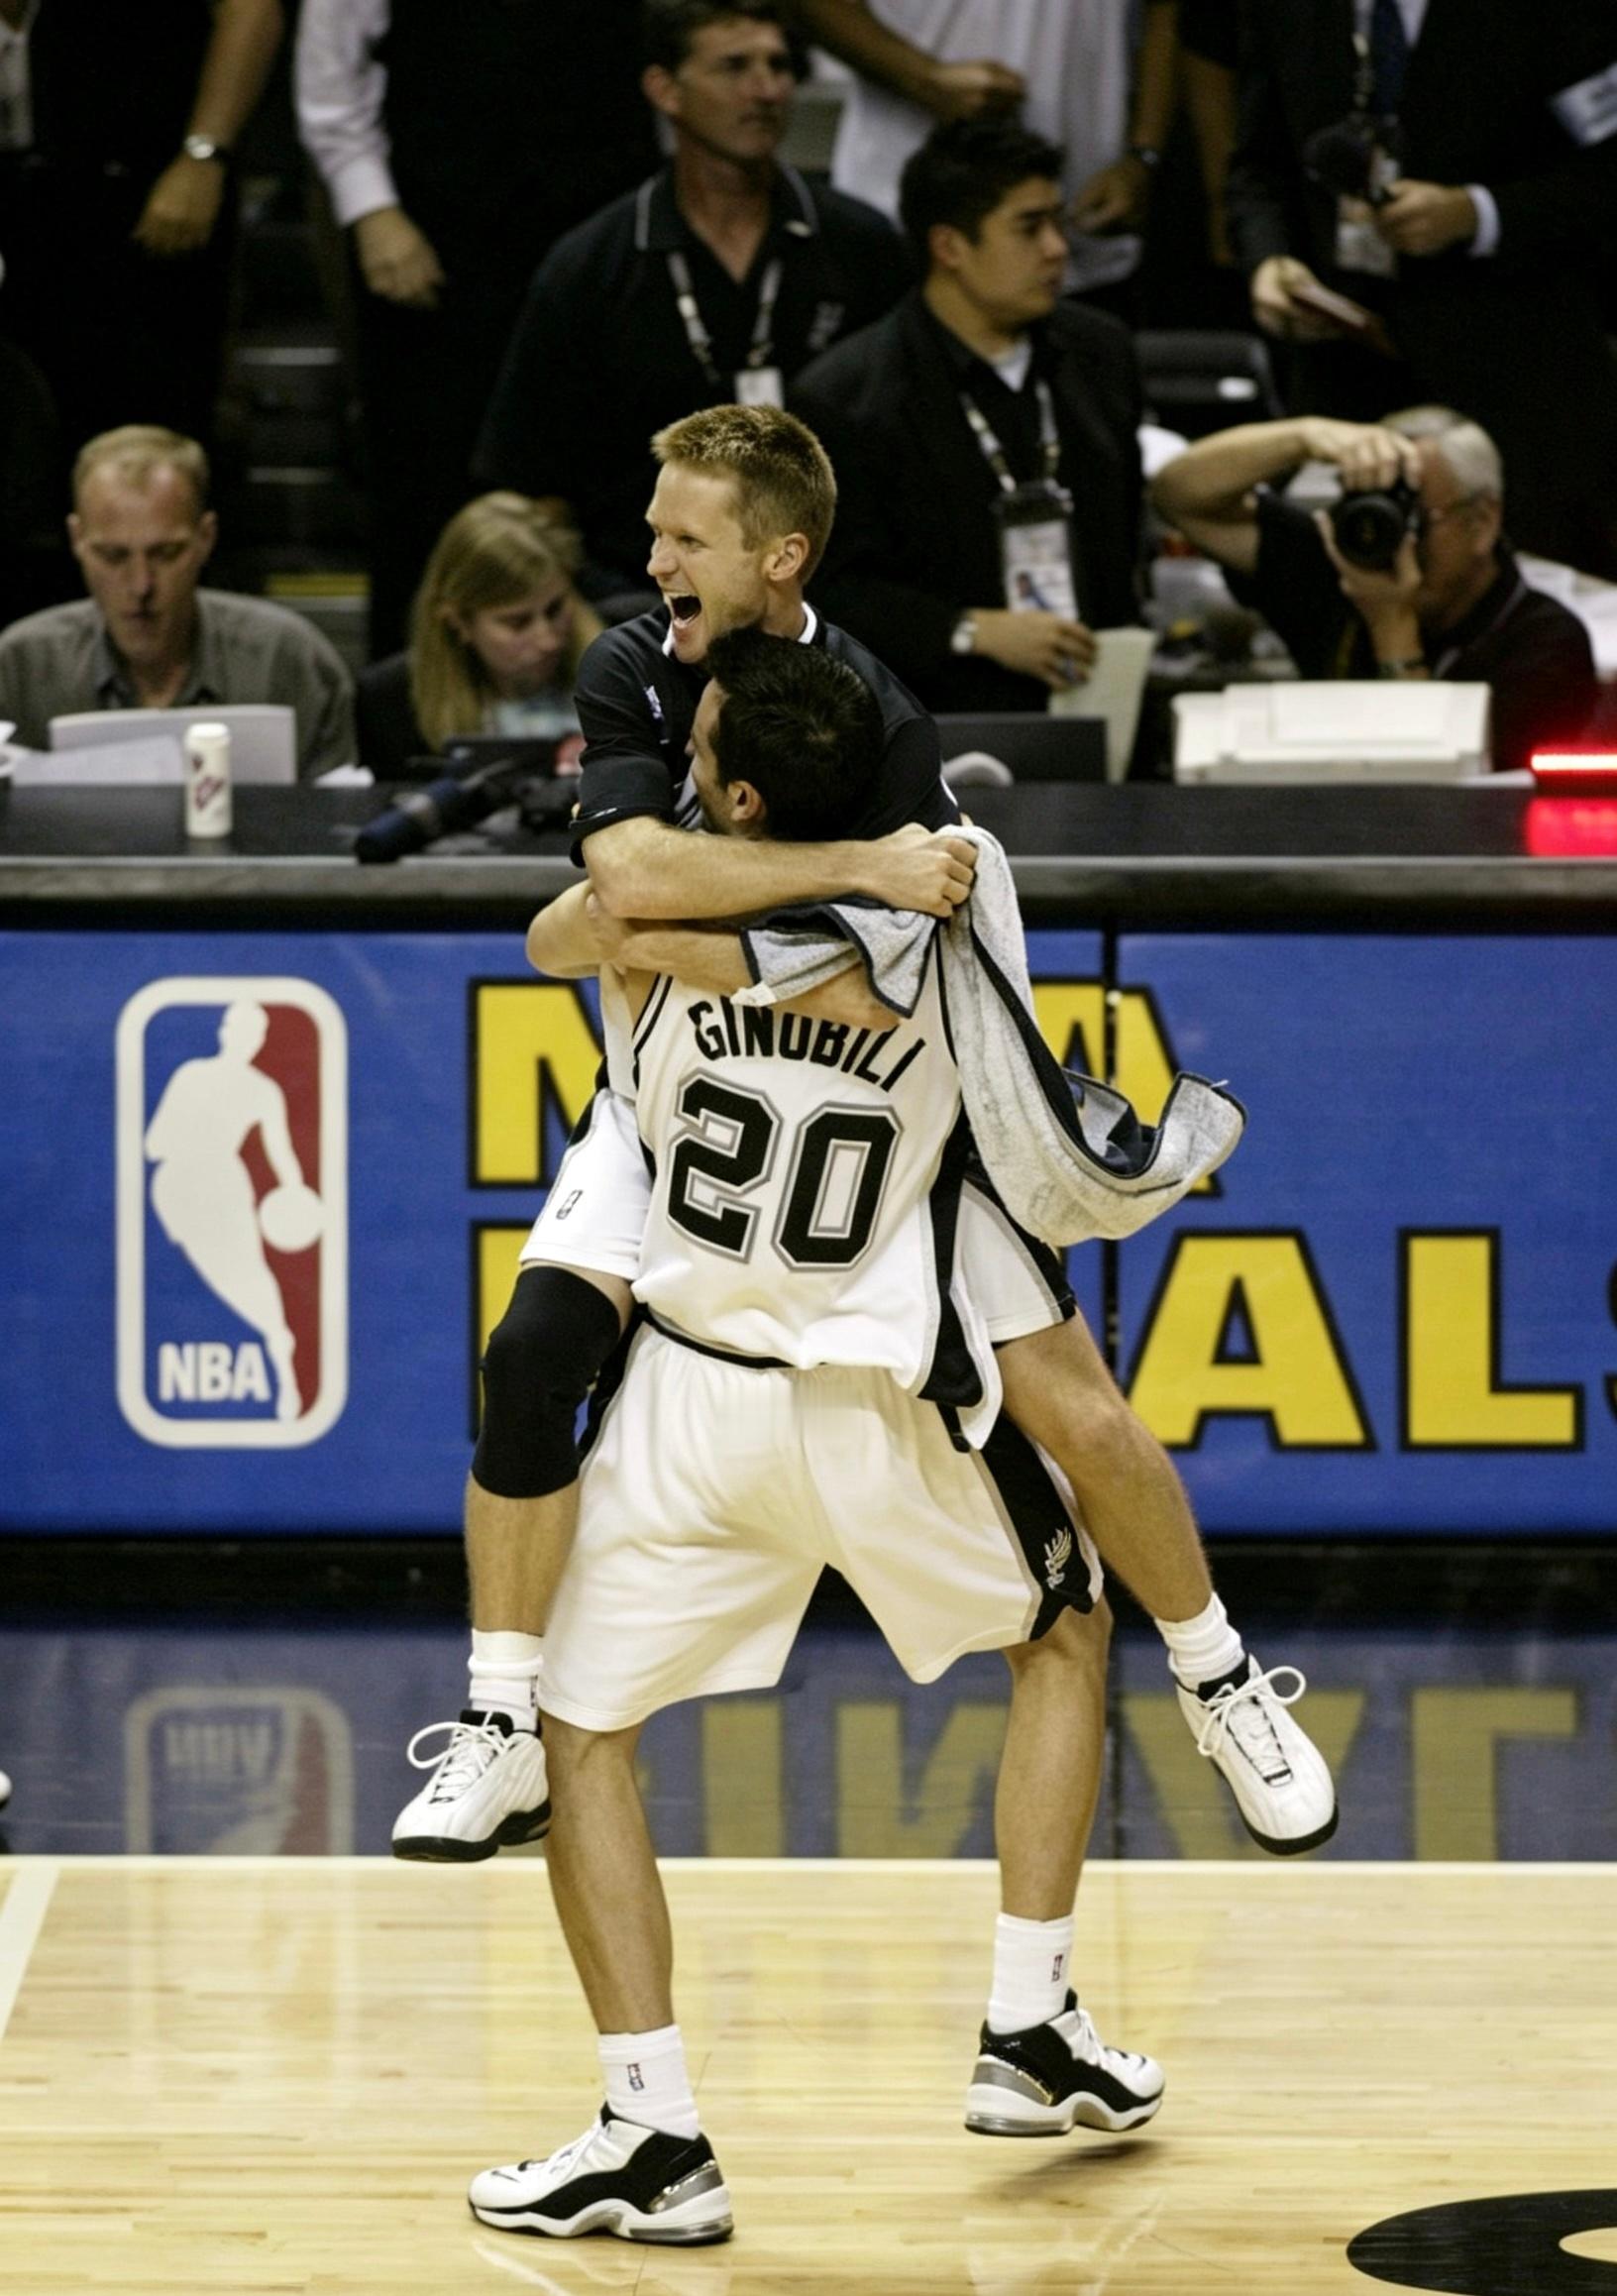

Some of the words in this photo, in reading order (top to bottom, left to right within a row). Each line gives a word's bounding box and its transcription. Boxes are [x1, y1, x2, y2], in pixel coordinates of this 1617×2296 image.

[688, 995, 925, 1093] GINOBILI
[668, 1067, 904, 1272] 20
[160, 1342, 272, 1402] NBA
